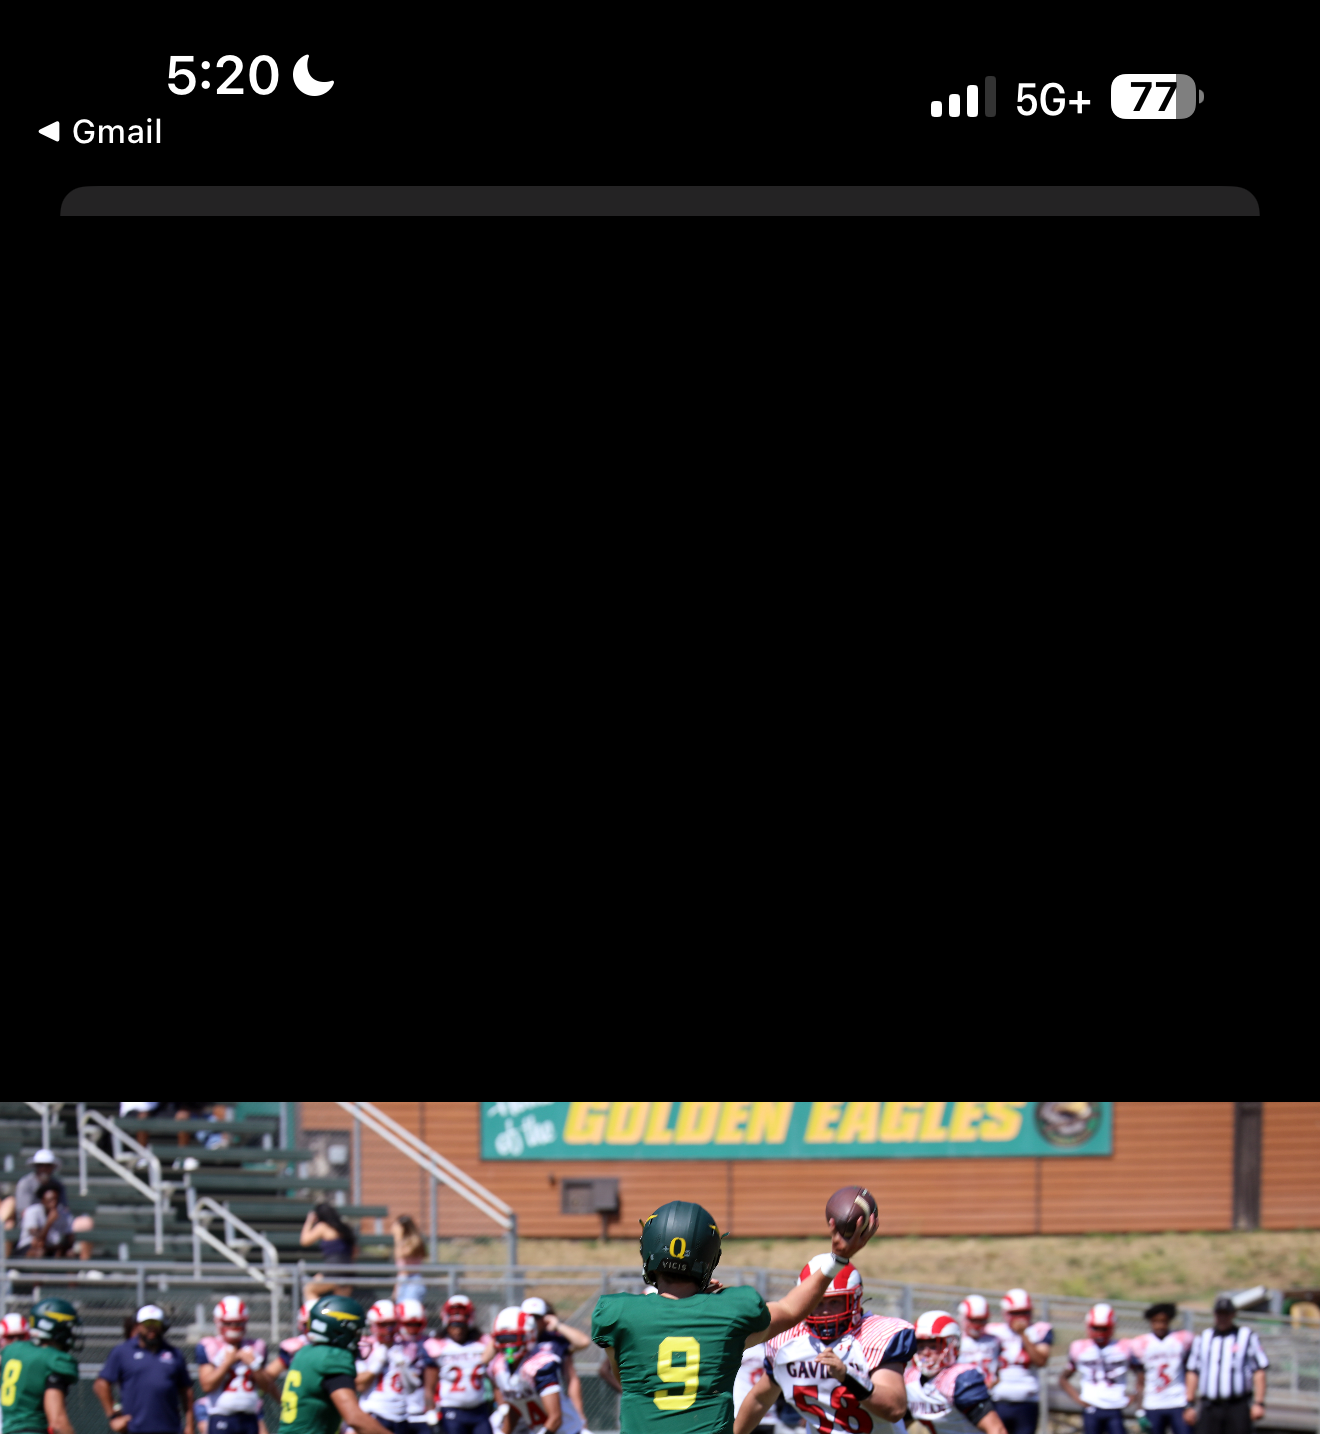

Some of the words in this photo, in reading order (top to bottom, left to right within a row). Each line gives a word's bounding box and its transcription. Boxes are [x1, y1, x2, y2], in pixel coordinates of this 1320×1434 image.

[562, 1102, 795, 1145] GOLDEN
[803, 1102, 1027, 1144] EAGLES
[662, 1260, 688, 1271] VICIS
[669, 1236, 687, 1260] Q
[1, 1358, 22, 1407] 8
[653, 1338, 701, 1411] 9
